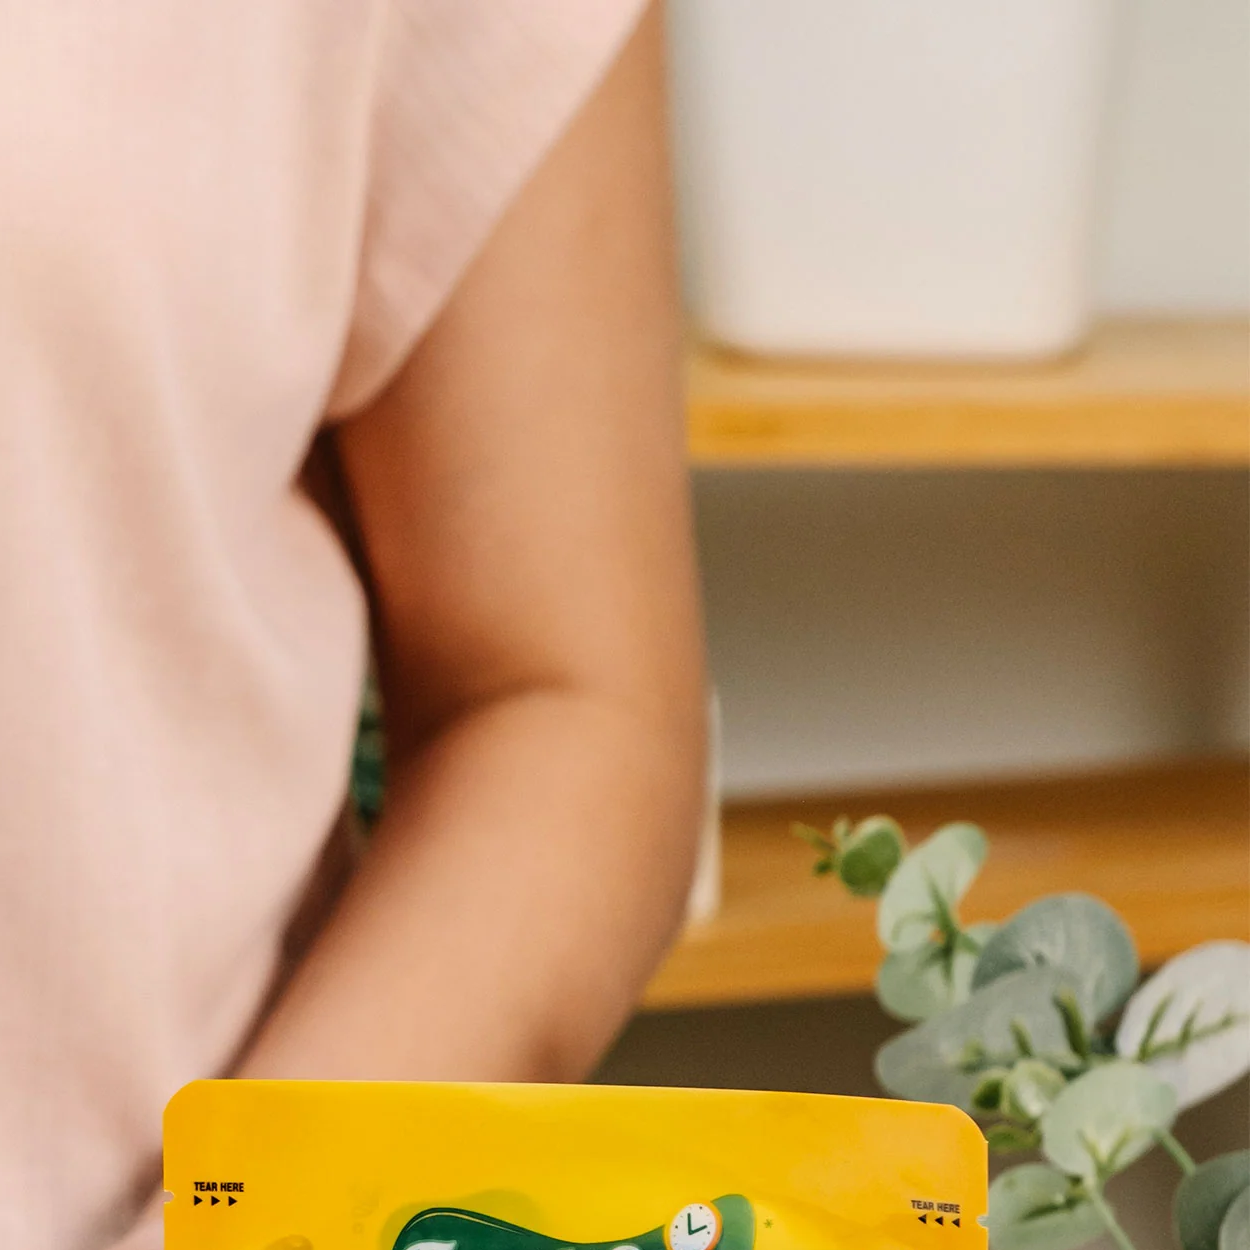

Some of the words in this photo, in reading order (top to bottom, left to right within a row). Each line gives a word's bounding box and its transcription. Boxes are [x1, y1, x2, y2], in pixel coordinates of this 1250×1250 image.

[193, 1182, 218, 1192] TEAR
[220, 1182, 245, 1192] HERE
[911, 1200, 934, 1211] TEAR
[937, 1203, 960, 1214] HERE
